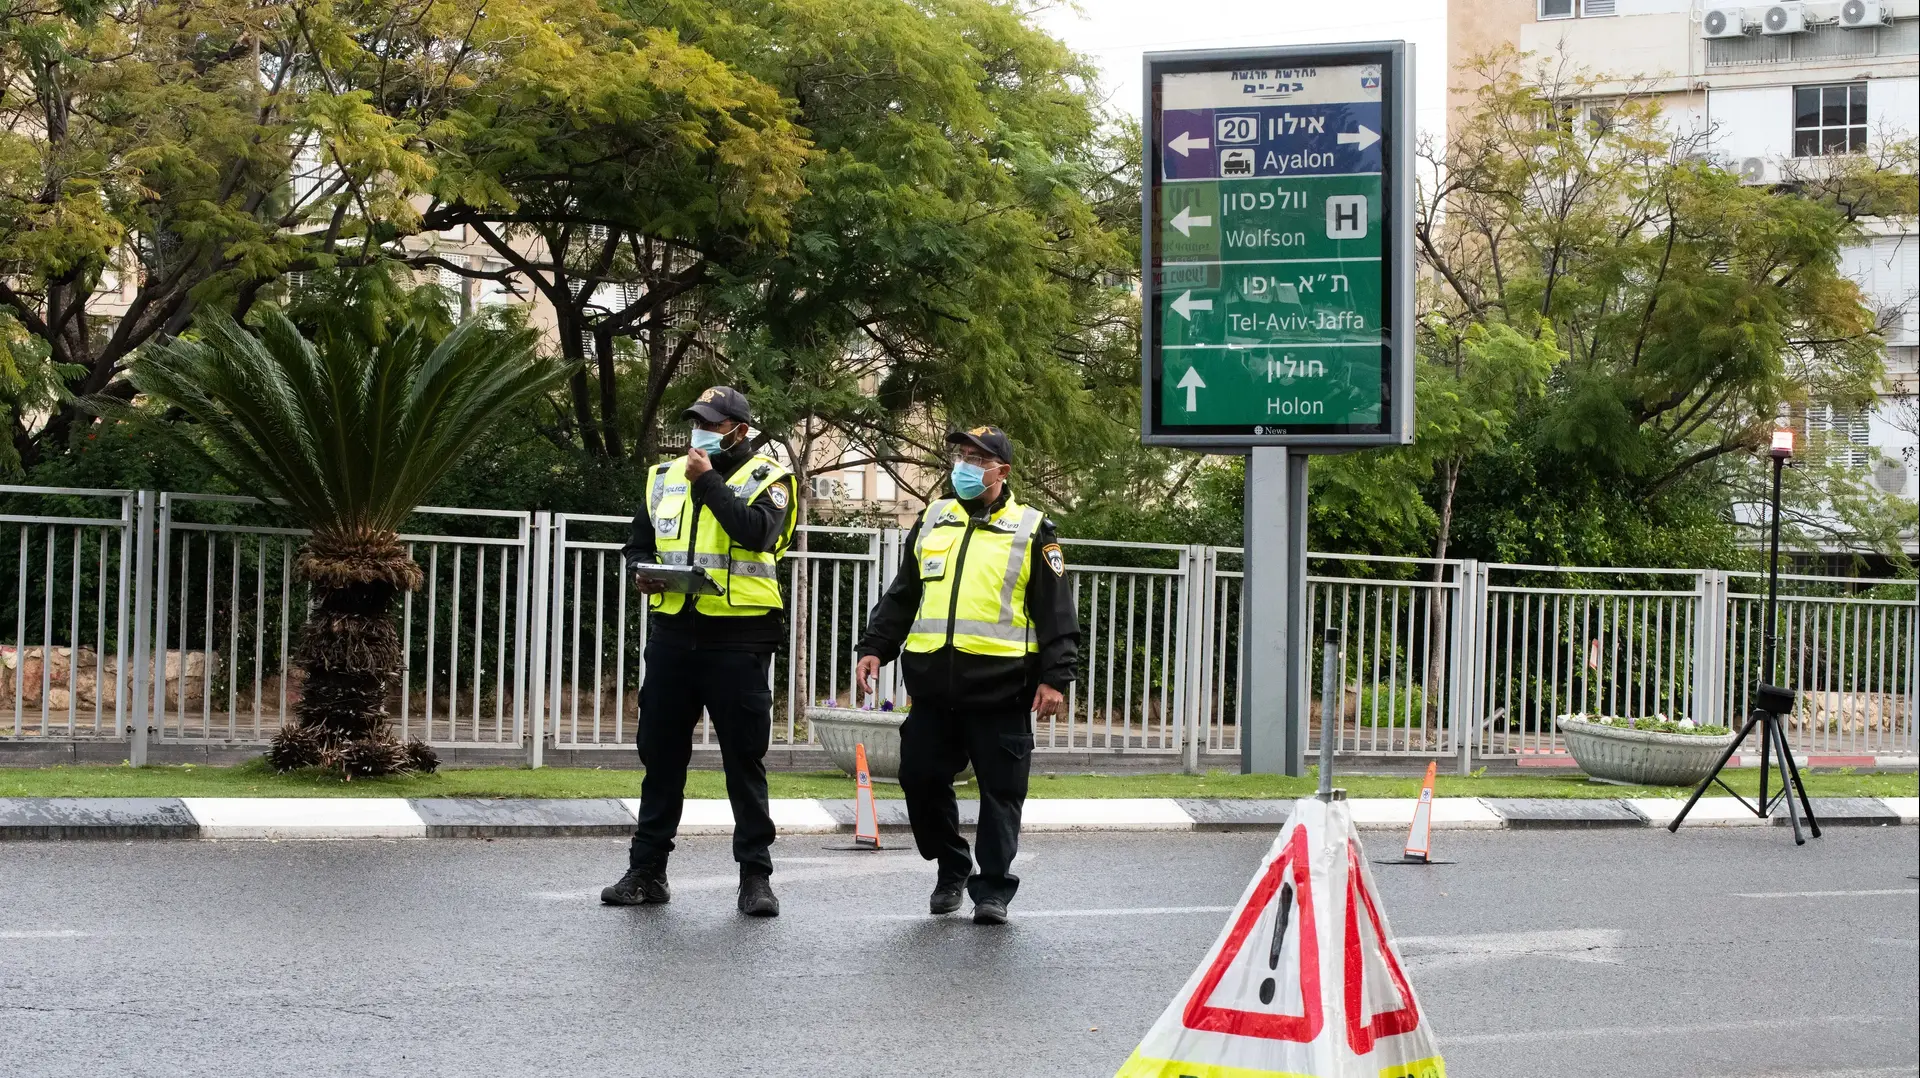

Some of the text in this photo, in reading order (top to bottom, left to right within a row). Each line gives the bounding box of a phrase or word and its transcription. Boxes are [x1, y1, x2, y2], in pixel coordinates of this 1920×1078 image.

[1242, 81, 1304, 94] בת-ים
[1223, 119, 1250, 140] 20
[1268, 112, 1325, 141] אילון
[1263, 150, 1335, 174] Ayalon
[1223, 187, 1307, 216] וולפסון
[1335, 202, 1358, 231] H
[1226, 228, 1305, 248] Wolfson
[1229, 311, 1364, 332] Tel-Aviv-Jaffa
[1267, 355, 1324, 383] חולון
[1267, 397, 1324, 416] Holon
